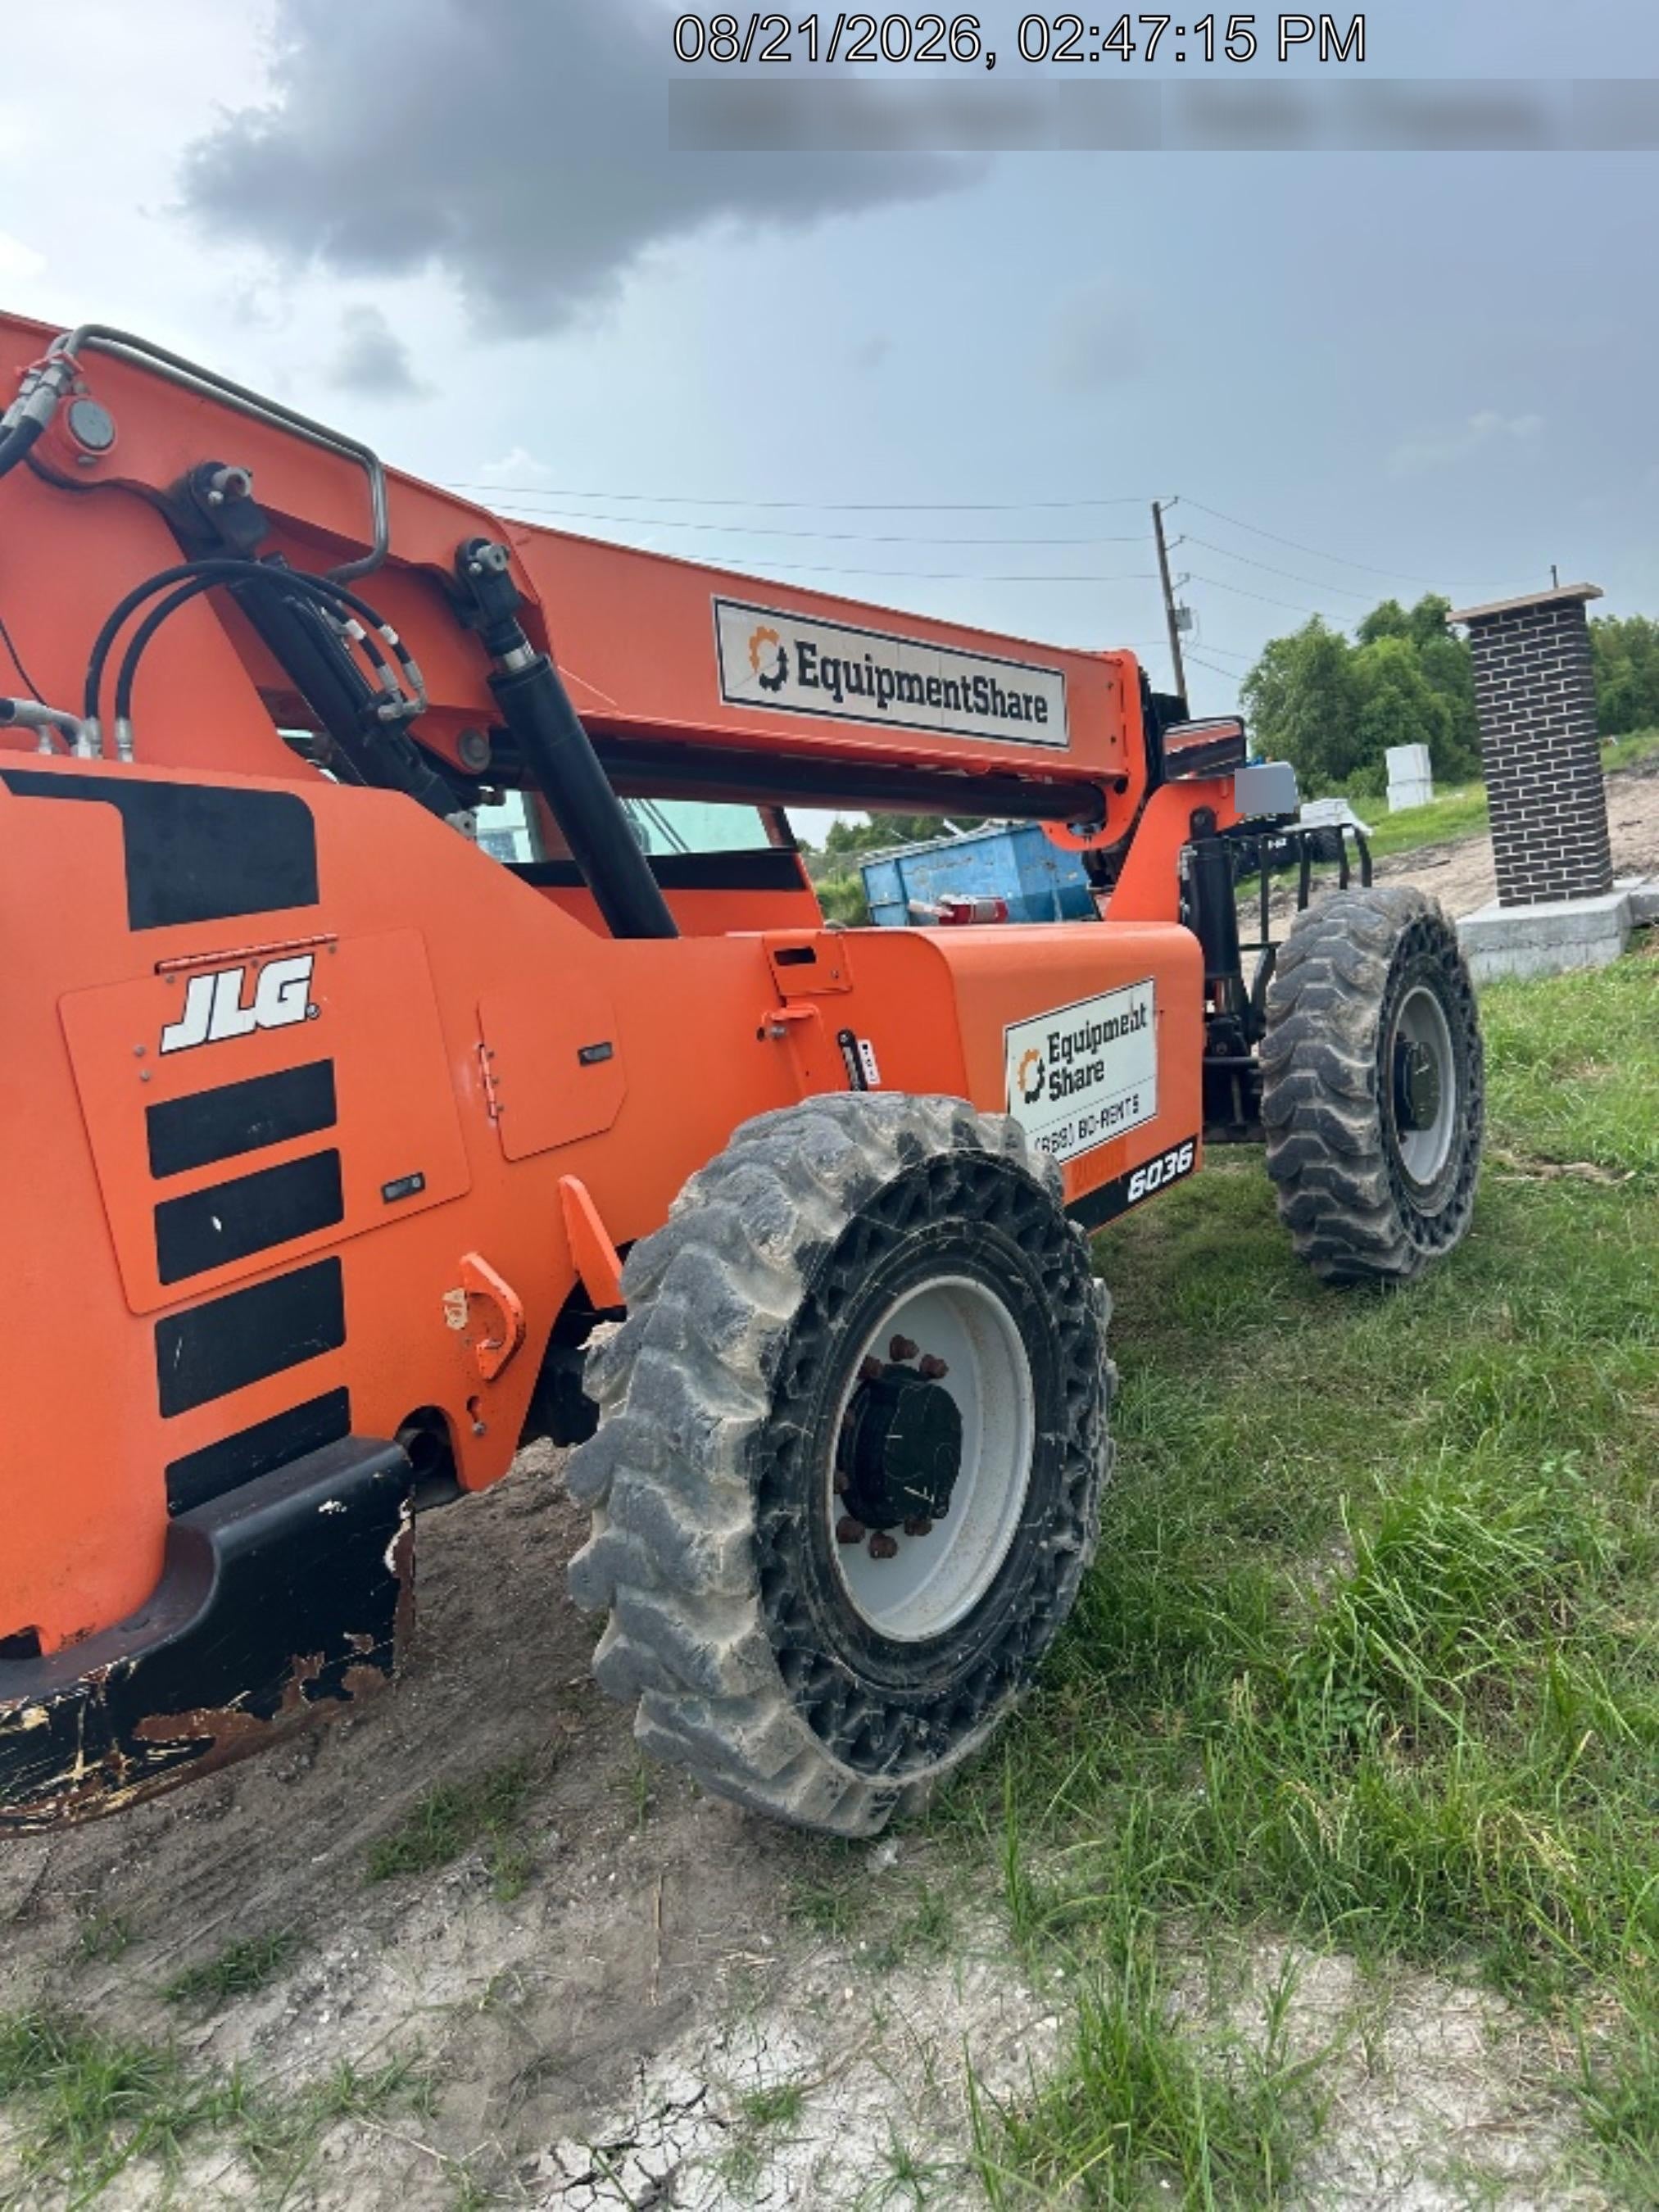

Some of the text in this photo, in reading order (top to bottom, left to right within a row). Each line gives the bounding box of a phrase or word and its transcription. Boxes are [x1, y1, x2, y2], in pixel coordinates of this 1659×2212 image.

[793, 639, 1049, 723] EquipmentShare
[1047, 1001, 1148, 1064] Equipment
[1049, 1058, 1105, 1102] Share
[1127, 1142, 1194, 1203] 6036
